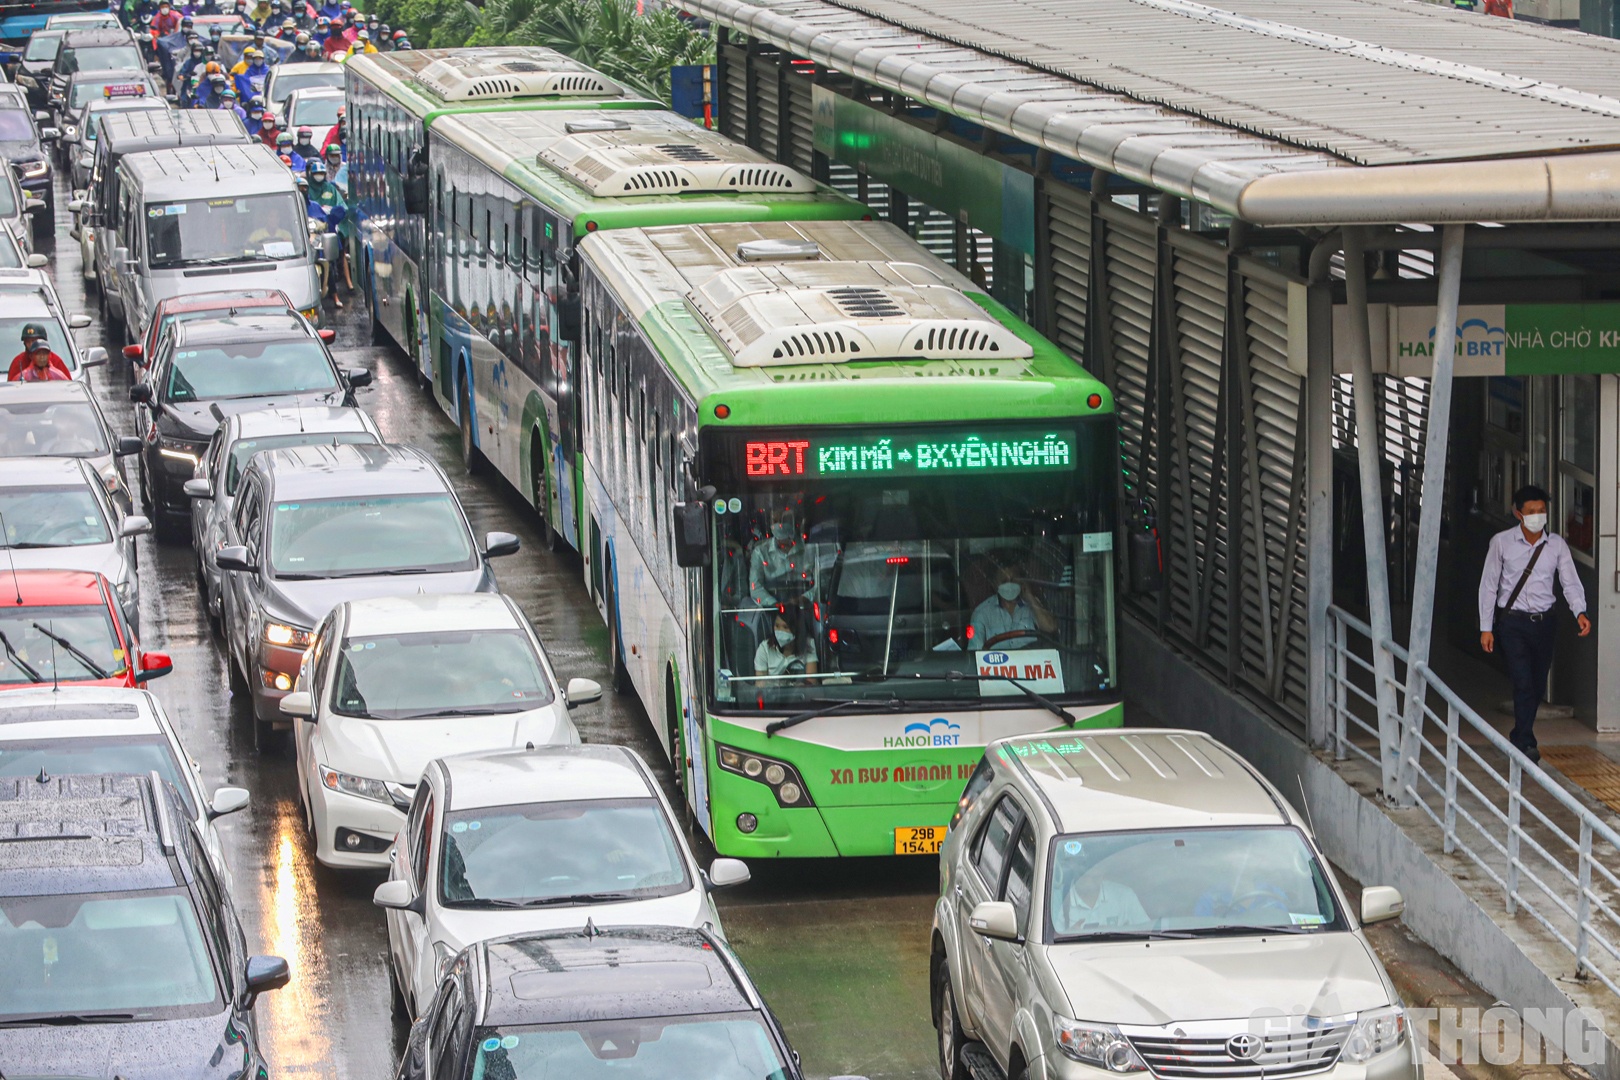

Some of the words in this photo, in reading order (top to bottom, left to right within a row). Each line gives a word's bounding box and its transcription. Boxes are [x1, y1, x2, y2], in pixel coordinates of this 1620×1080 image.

[1400, 341, 1462, 357] HAI
[1467, 341, 1504, 356] BRT
[1505, 327, 1545, 348] NHÀ
[1550, 326, 1591, 348] CHỜ
[746, 441, 810, 475] BRT
[819, 446, 857, 472] KIM
[860, 439, 893, 470] MÃ
[1001, 434, 1069, 467] NGHĨA
[988, 653, 1004, 663] BRT
[980, 665, 1018, 681] KIM
[1024, 660, 1057, 680] MÃ
[883, 735, 931, 748] HANOI
[933, 734, 960, 746] BRT
[858, 767, 889, 784] BUS
[893, 765, 952, 783] NHANH
[911, 828, 935, 840] 29B
